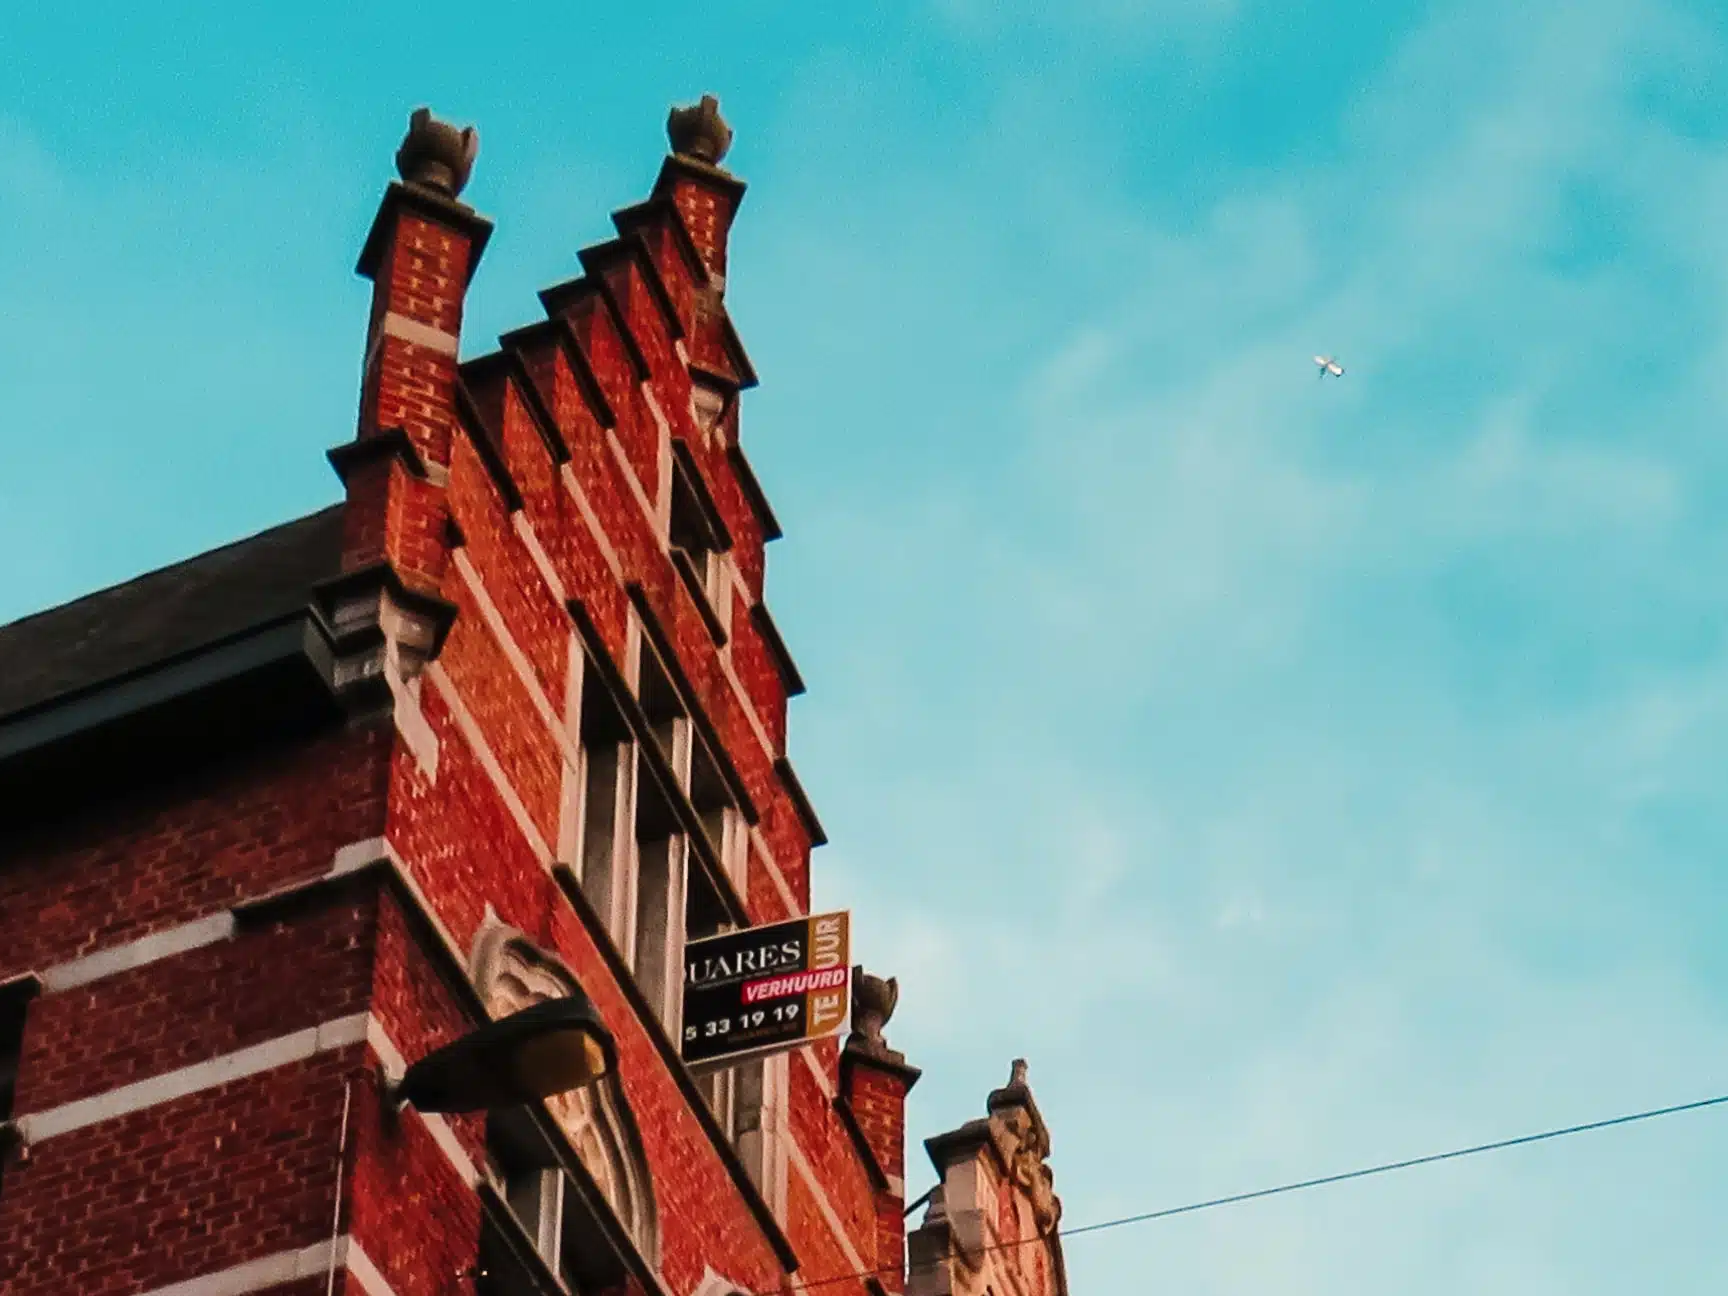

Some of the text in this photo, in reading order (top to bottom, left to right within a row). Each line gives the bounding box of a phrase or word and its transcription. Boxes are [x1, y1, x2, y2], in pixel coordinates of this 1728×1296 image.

[686, 940, 801, 984] UARES
[813, 917, 841, 1026] TE UUR
[745, 969, 846, 1003] VERHUURD
[705, 1018, 731, 1037] 33
[740, 1010, 765, 1028] 19
[773, 1004, 799, 1021] 19
